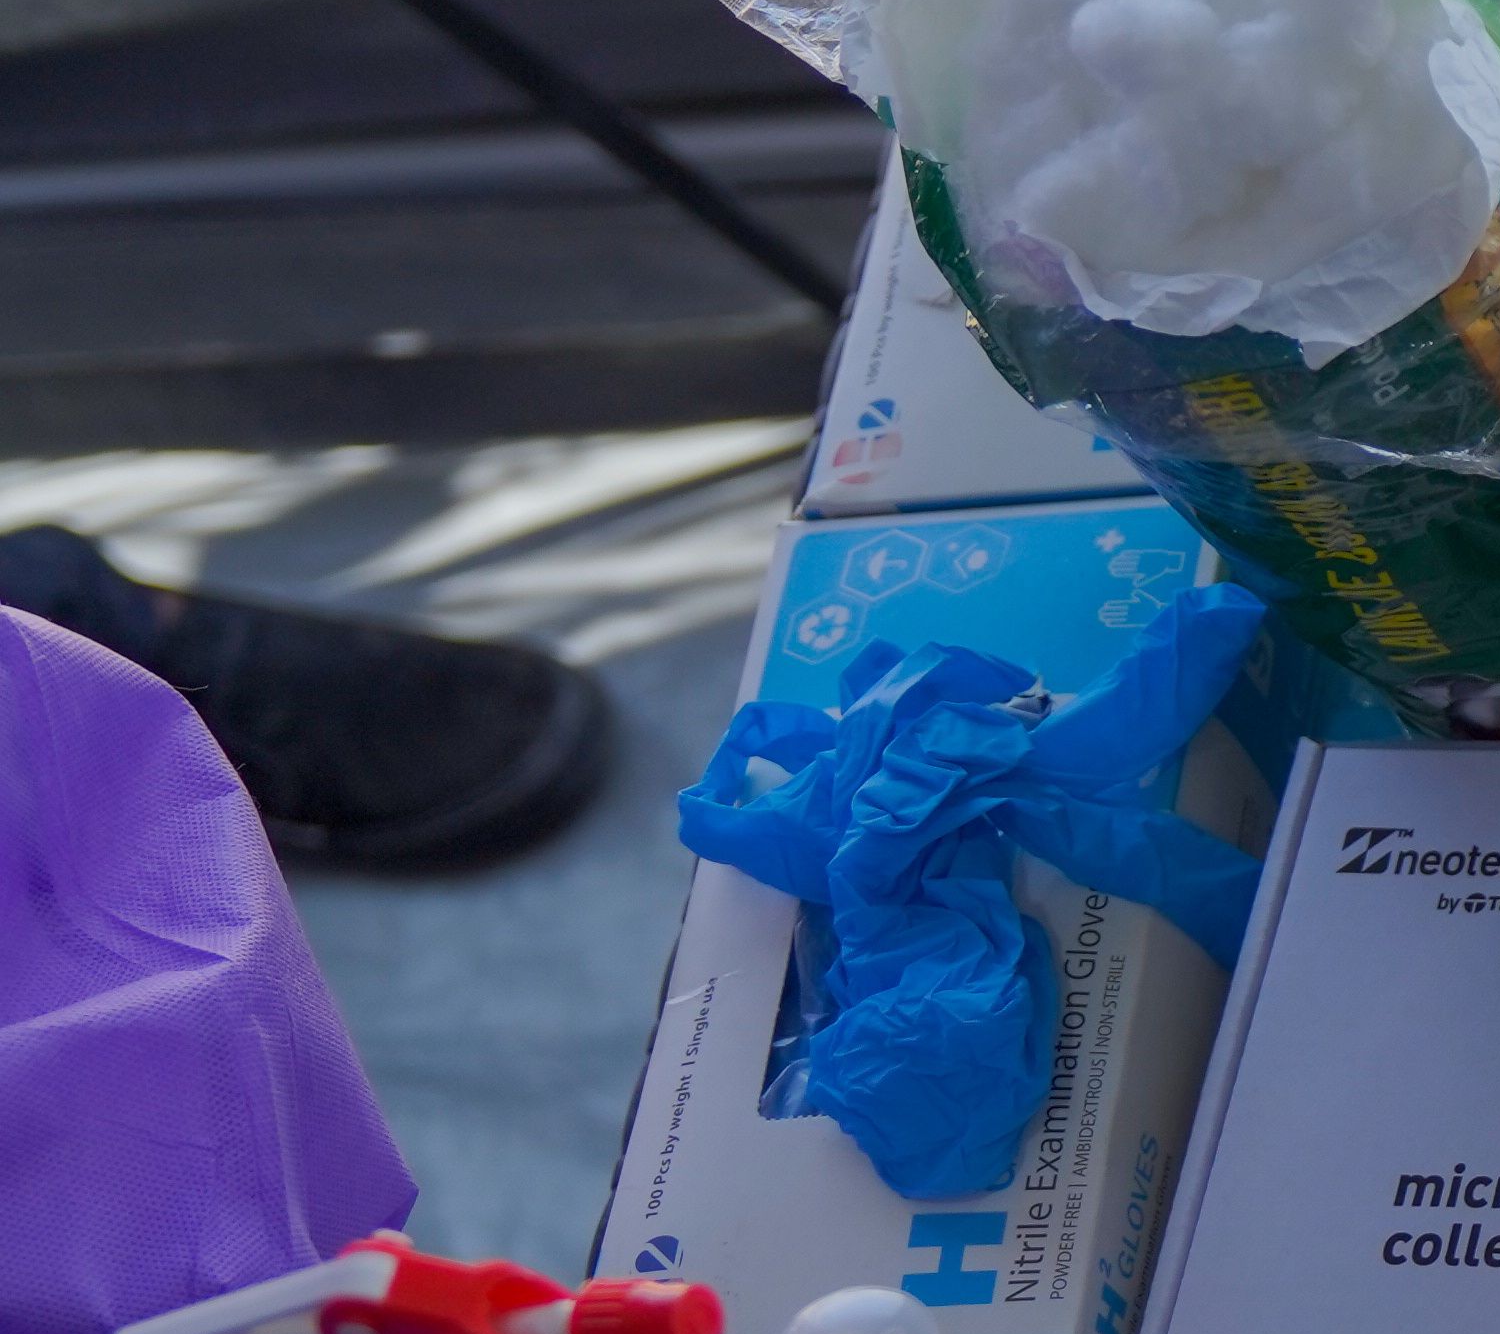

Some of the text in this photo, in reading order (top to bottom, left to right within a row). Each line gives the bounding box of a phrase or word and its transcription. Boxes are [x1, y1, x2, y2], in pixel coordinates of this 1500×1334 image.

[683, 1005, 712, 1058] Single
[667, 1072, 694, 1132] weight
[1023, 989, 1091, 1192] Examination
[659, 1133, 681, 1155] by
[1047, 952, 1128, 1301] POWDER FREE AMBIDEXTROUS NON-STERILE
[652, 1157, 672, 1185] Pcs
[644, 1187, 665, 1219] 100
[1116, 1131, 1160, 1275] GLOVES
[1002, 1200, 1054, 1303] Nitrile
